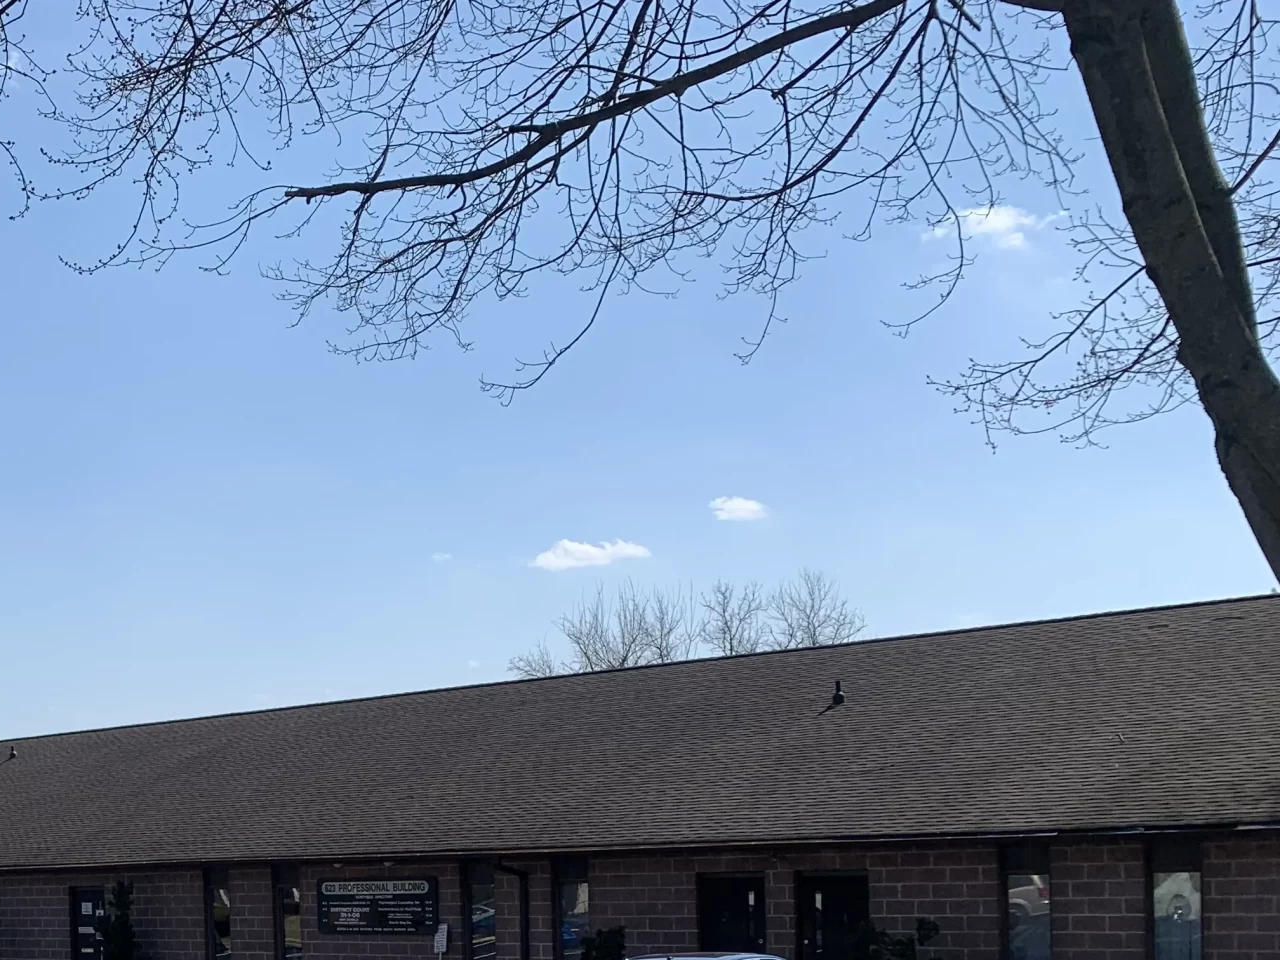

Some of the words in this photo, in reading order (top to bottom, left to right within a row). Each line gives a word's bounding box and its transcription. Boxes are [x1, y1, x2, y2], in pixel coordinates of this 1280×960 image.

[324, 884, 336, 892] 623
[338, 883, 390, 892] PROFESSIONAL
[392, 882, 426, 892] BUILDING
